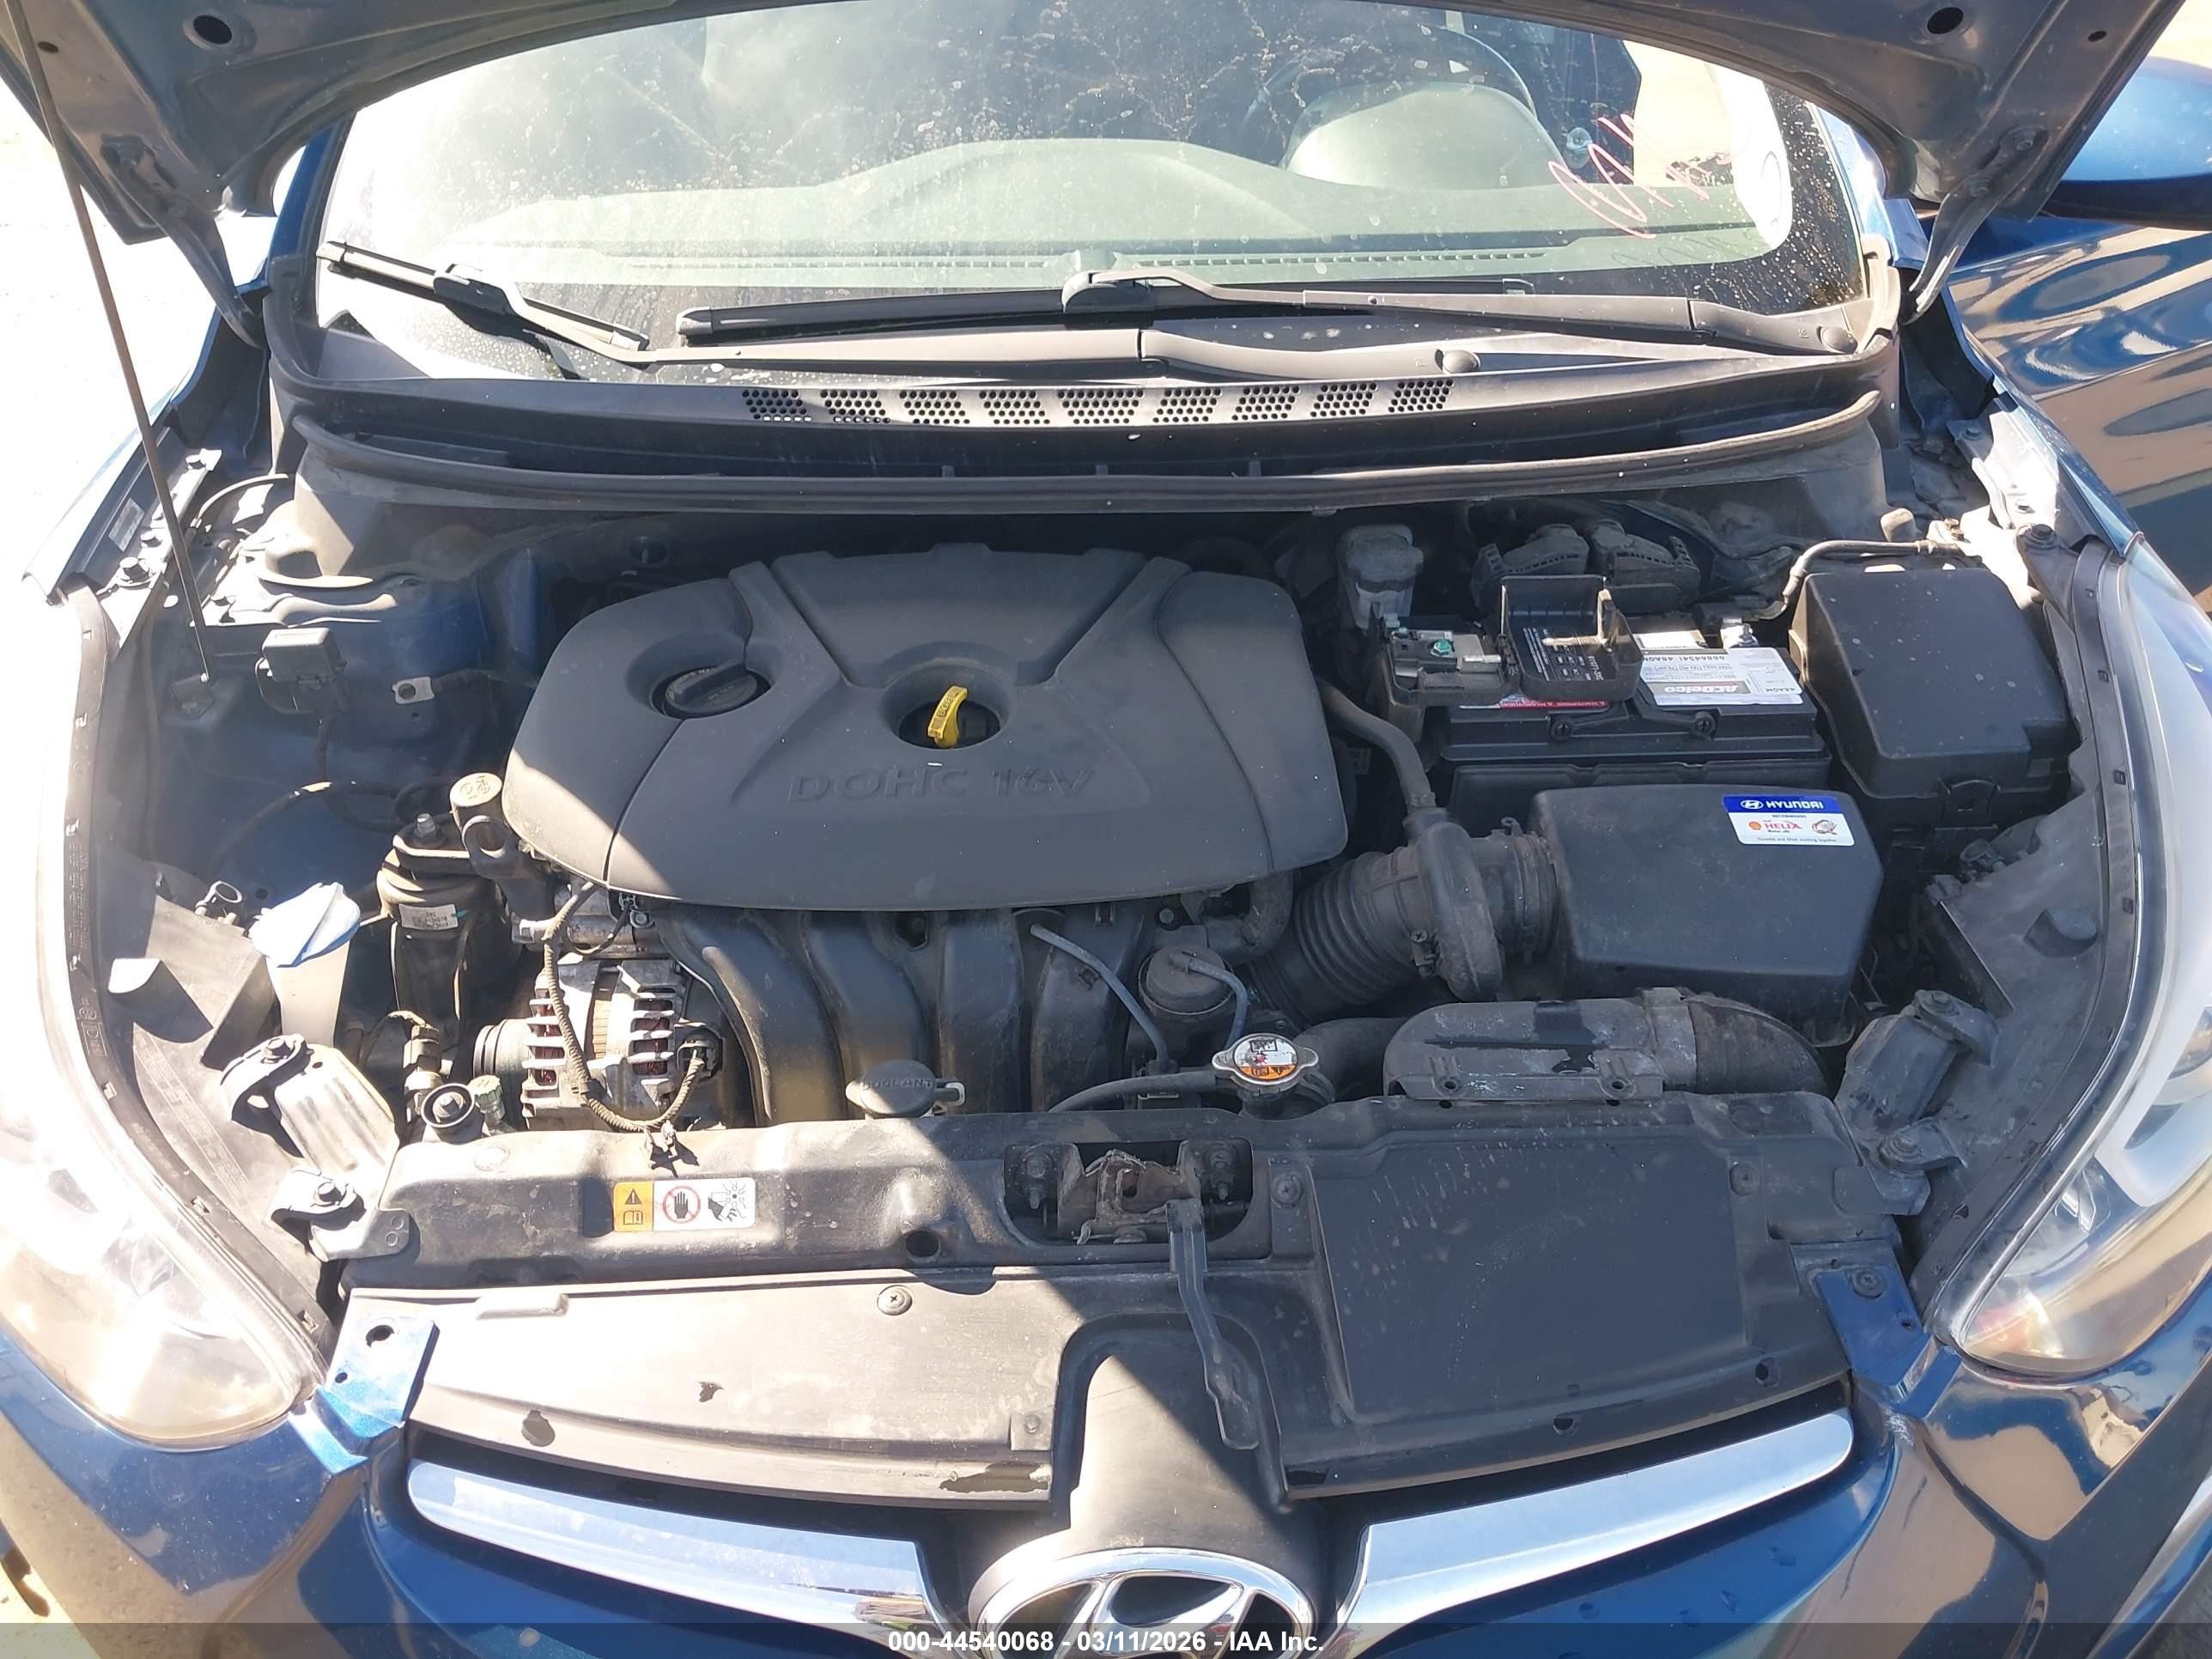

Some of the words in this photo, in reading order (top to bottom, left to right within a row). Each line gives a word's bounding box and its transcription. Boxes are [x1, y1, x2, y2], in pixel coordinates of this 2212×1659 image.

[787, 766, 969, 802] DOHC
[990, 766, 1095, 799] 16V
[1765, 800, 1824, 809] HYUNDAI
